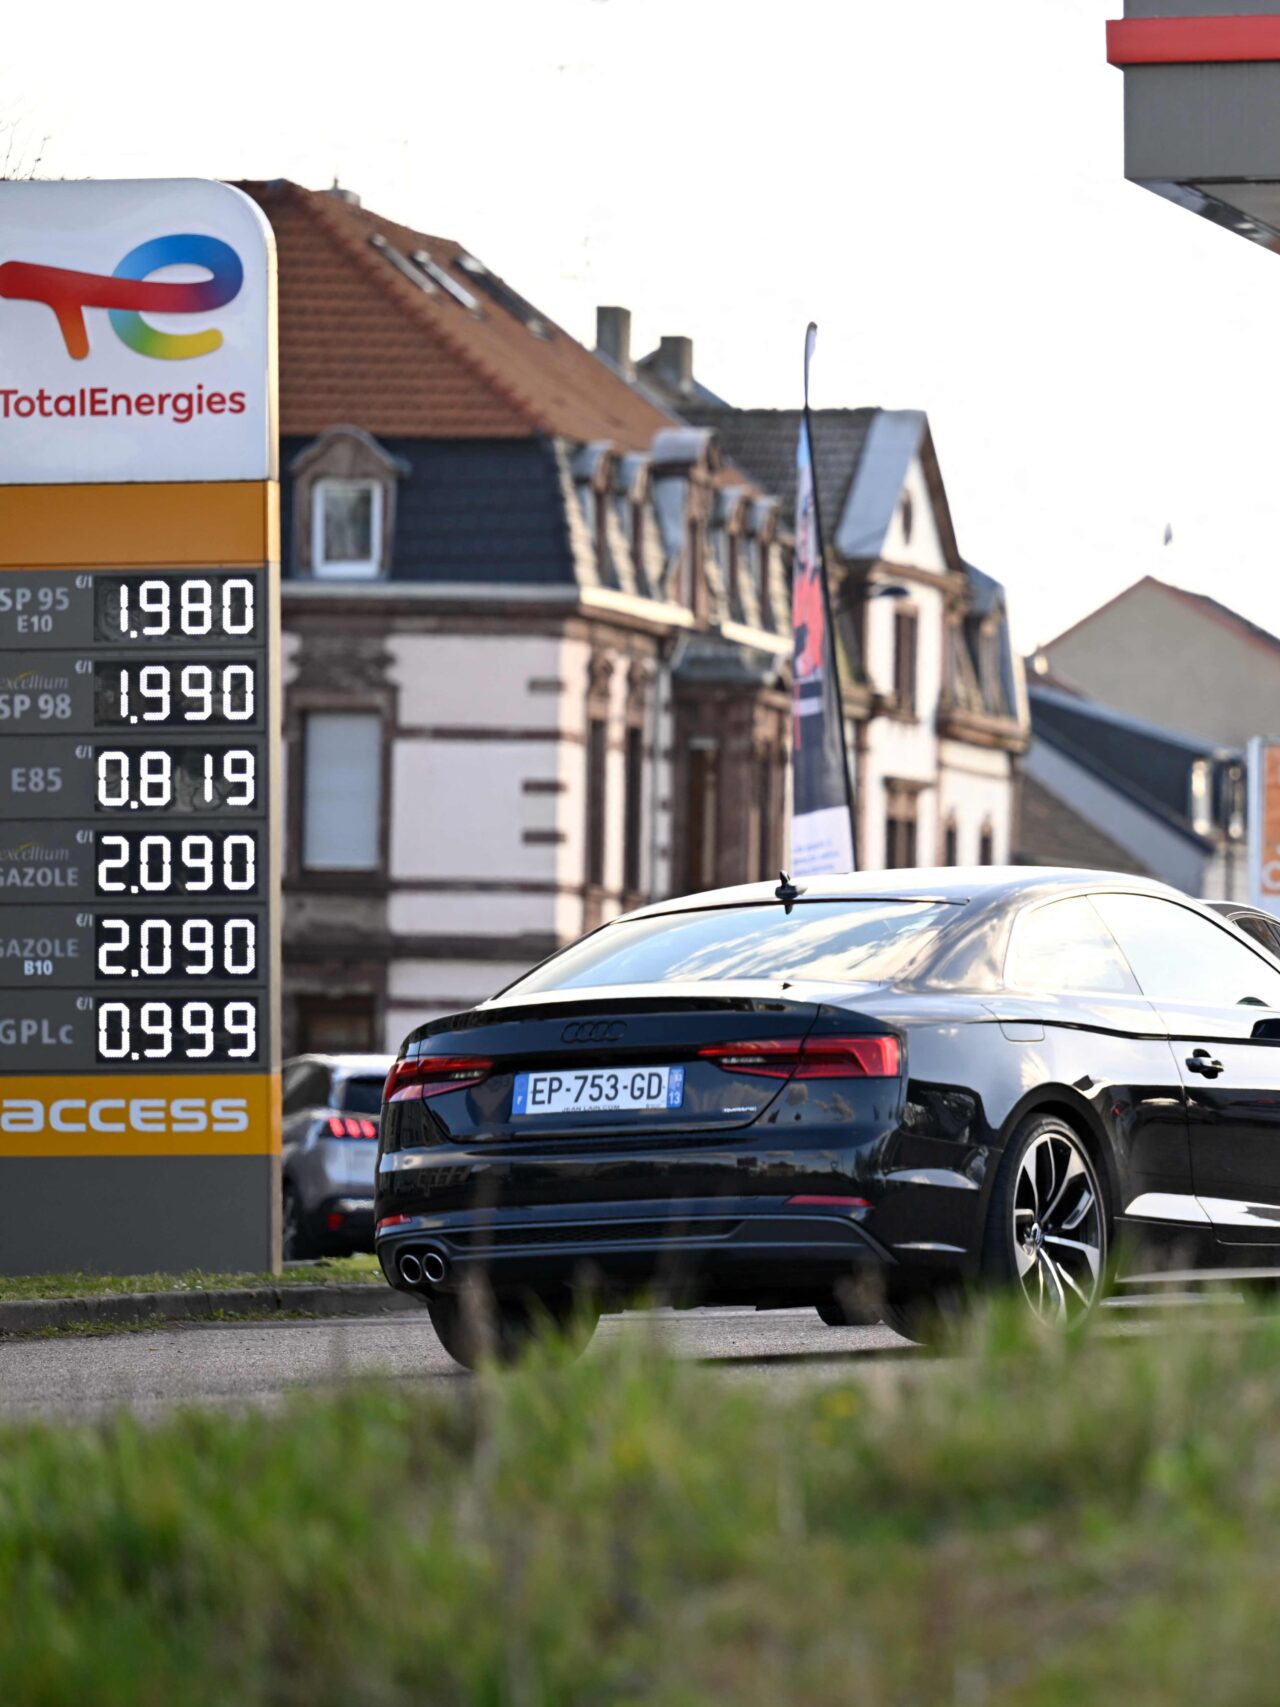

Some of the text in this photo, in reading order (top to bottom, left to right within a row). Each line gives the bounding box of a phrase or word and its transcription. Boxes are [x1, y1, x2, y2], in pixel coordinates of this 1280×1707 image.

[0, 384, 246, 424] TotalEnergies
[0, 586, 70, 611] SP 95
[120, 579, 254, 638] 1.980
[17, 614, 53, 633] E10
[0, 692, 72, 720] SP 98
[120, 665, 254, 724] 1.990
[11, 767, 63, 792] E85
[98, 750, 254, 809] 0.819
[98, 835, 255, 893] 2.090
[98, 919, 256, 977] 2.090
[23, 959, 53, 976] B10
[0, 1018, 74, 1045] GPLc
[98, 1002, 256, 1060] 0.999
[531, 1072, 663, 1105] EP-753-GD
[668, 1091, 681, 1105] 13
[0, 1098, 249, 1133] access
